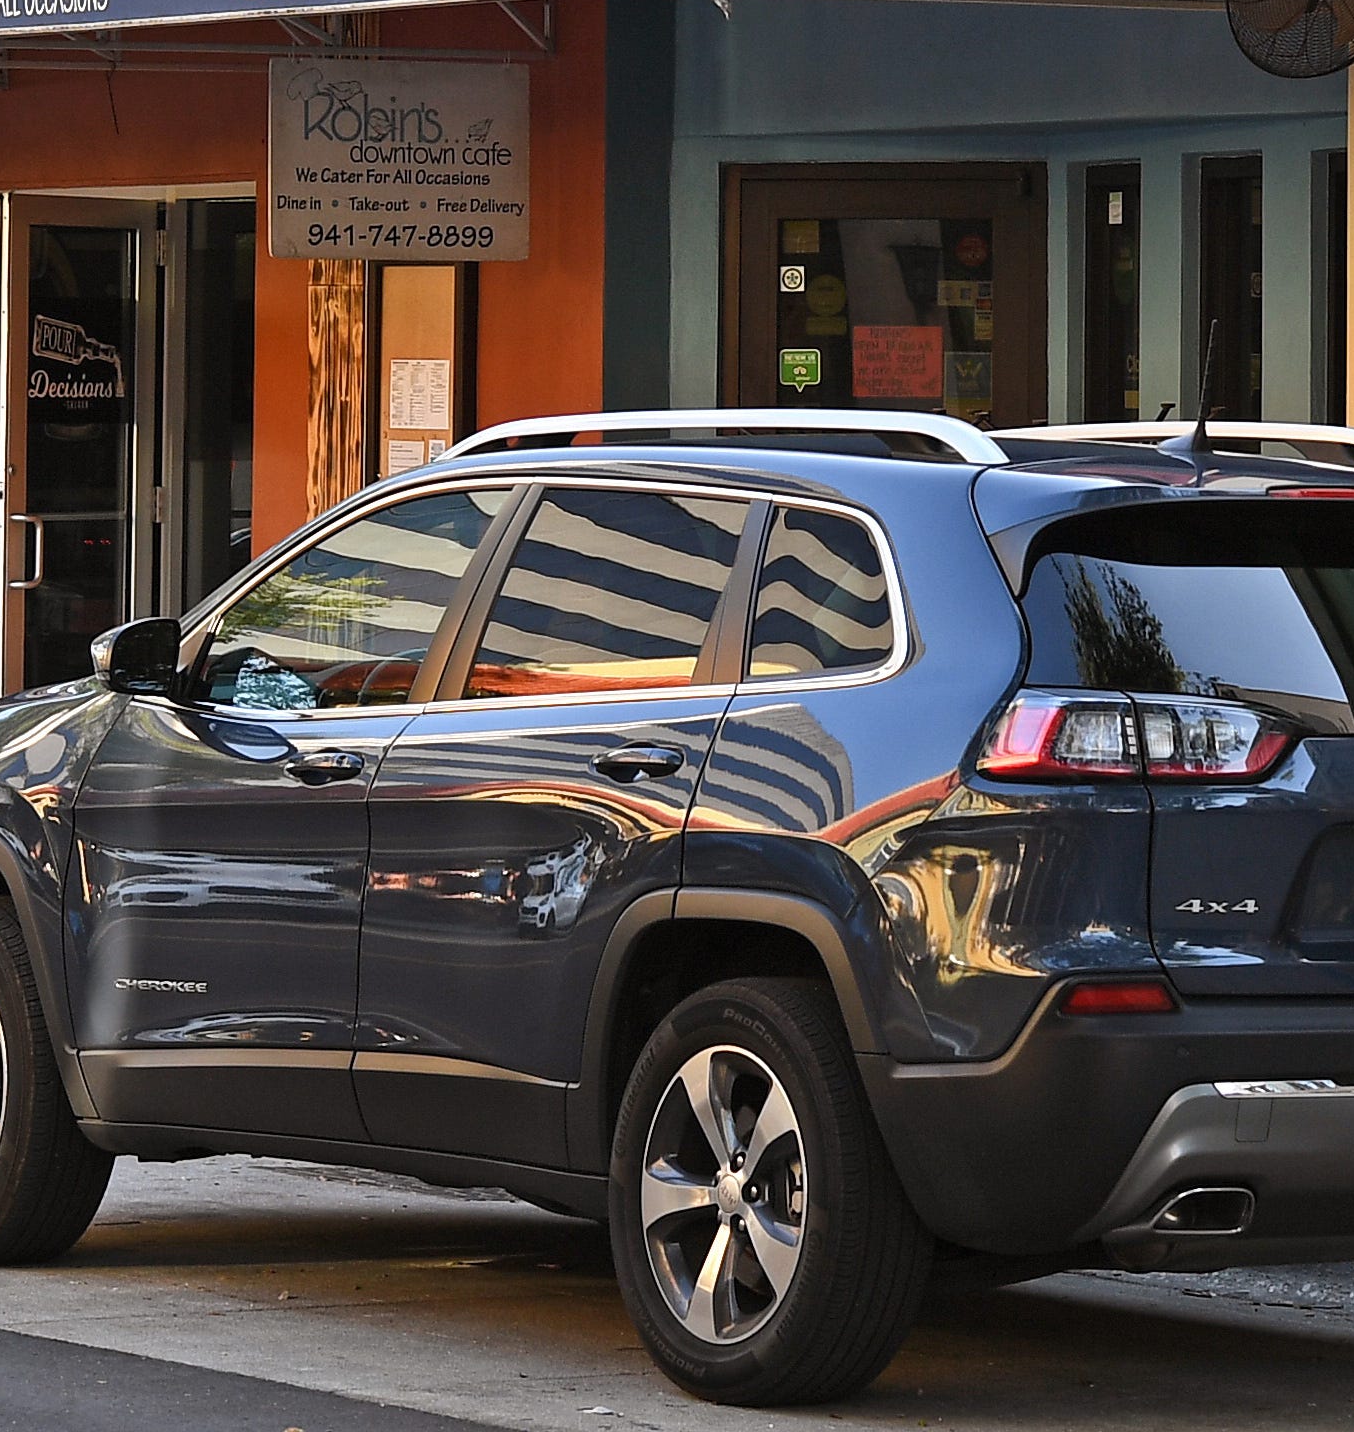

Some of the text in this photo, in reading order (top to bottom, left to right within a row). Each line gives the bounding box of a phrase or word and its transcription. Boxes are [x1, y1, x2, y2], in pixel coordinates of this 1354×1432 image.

[349, 138, 513, 167] downtown cafe
[295, 167, 491, 186] We Cater For All Occasions
[276, 195, 525, 217] Dine in Take-out Free Delivery
[306, 223, 495, 249] 941-747-8899
[42, 325, 76, 355] POUR
[27, 368, 114, 399] Decisions
[1174, 898, 1260, 915] 4x4
[114, 977, 209, 994] CHEROKEE
